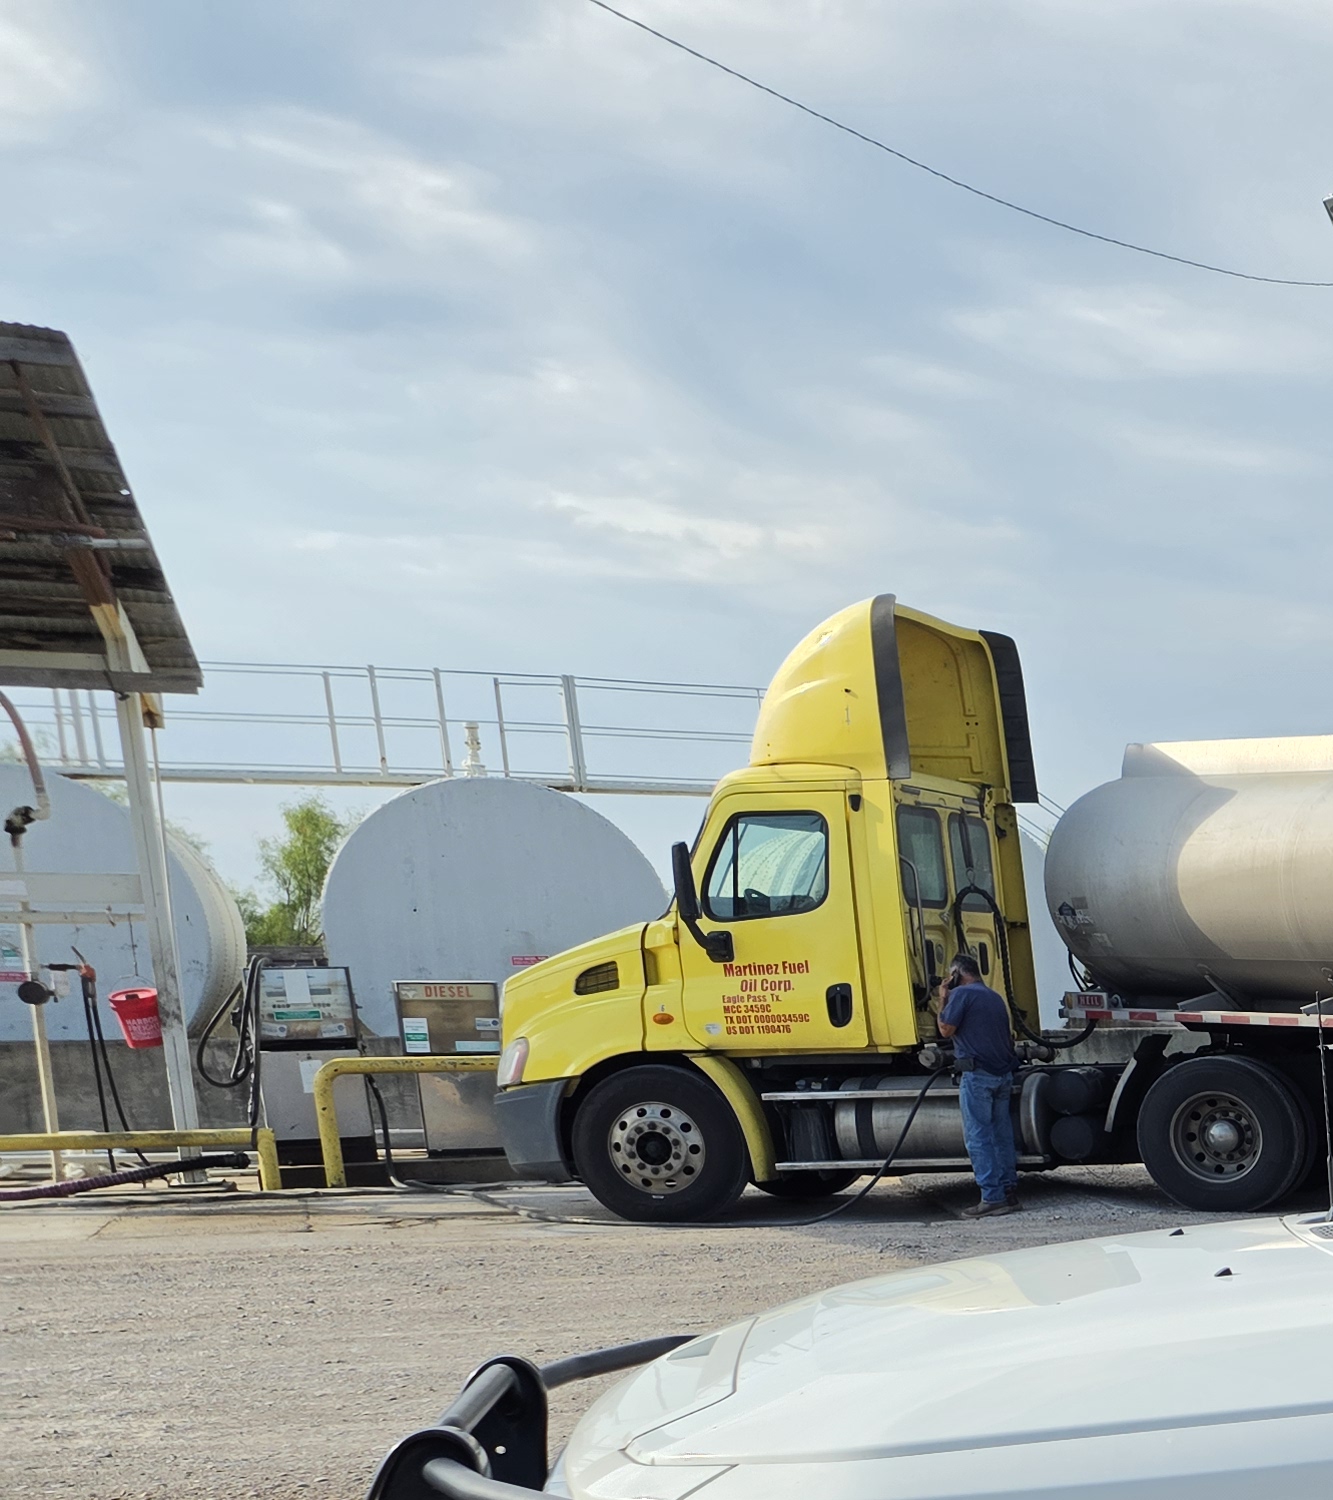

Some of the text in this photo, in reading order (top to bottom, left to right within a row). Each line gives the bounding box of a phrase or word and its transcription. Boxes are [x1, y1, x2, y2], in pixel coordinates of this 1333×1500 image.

[723, 960, 810, 977] Martinez Fuel
[740, 978, 795, 993] Oil Corp.
[424, 985, 474, 998] DIESEL
[722, 994, 745, 1004] Eagle
[747, 994, 767, 1003] Pass
[1079, 996, 1099, 1006] HEIL
[723, 1004, 772, 1014] MCC 3459C
[724, 1016, 735, 1025] TX
[736, 1015, 752, 1024] DOT
[726, 1026, 738, 1035] US
[739, 1025, 755, 1035] DOT
[757, 1024, 792, 1034] 1190476
